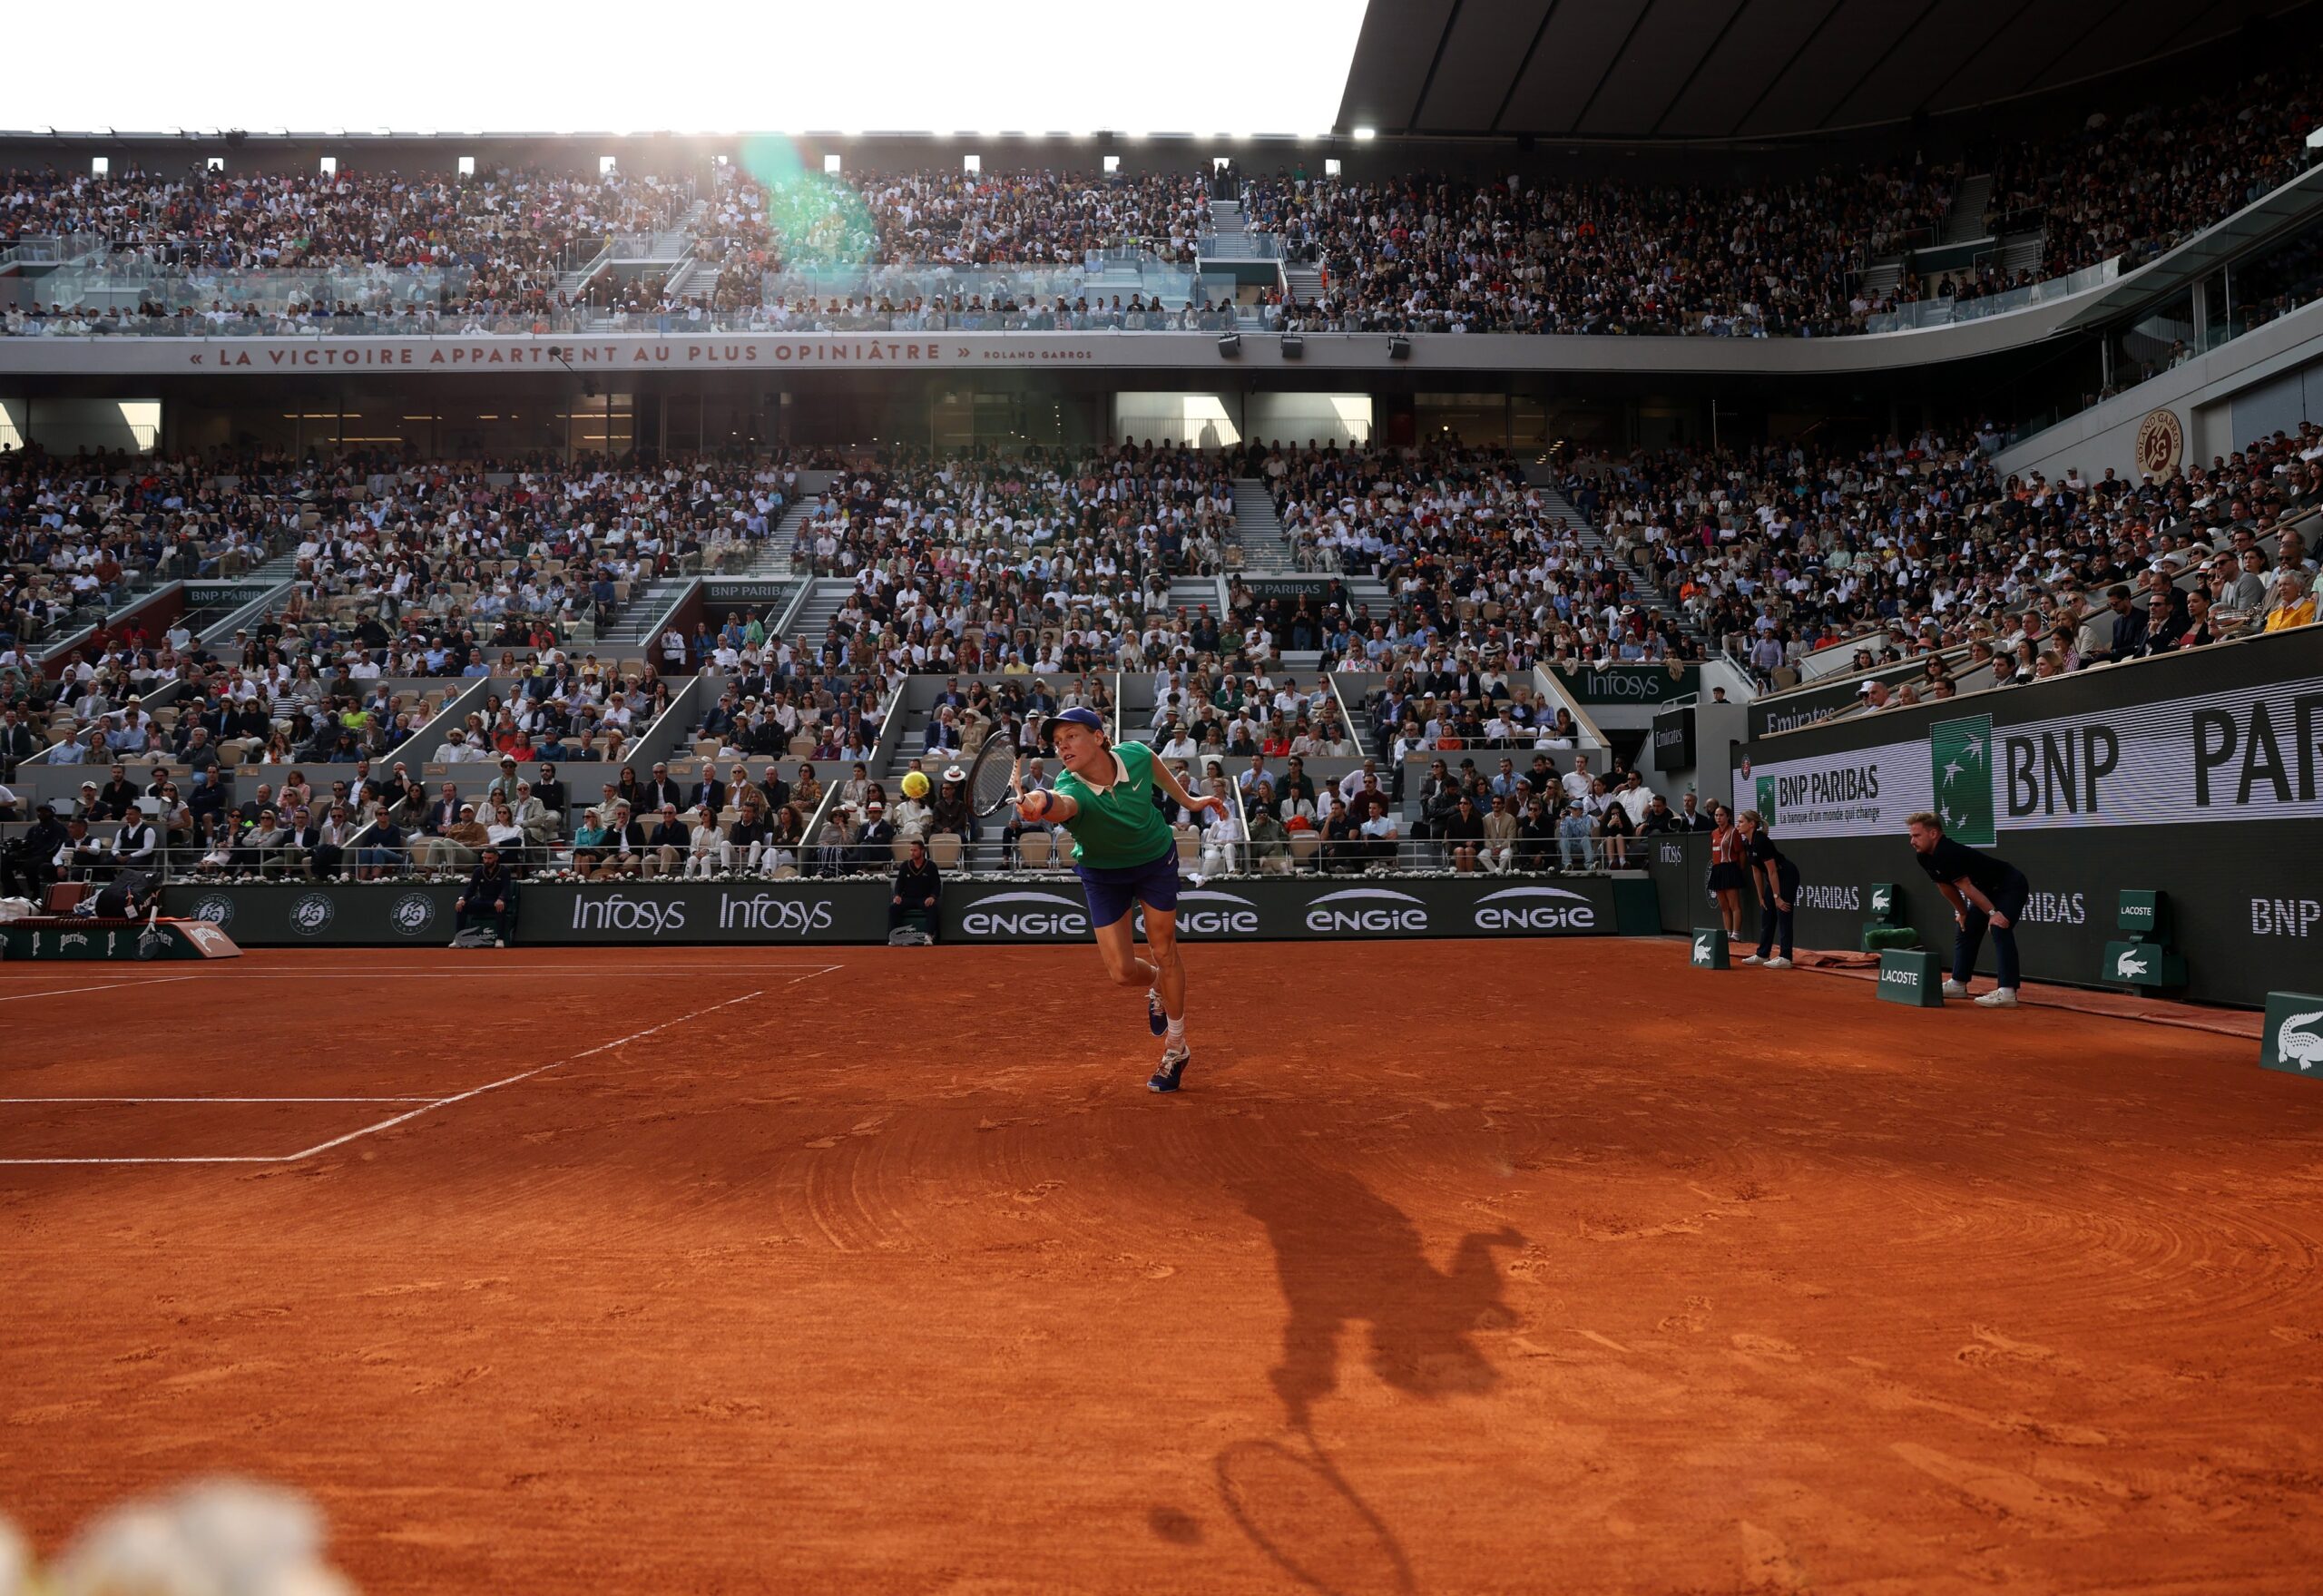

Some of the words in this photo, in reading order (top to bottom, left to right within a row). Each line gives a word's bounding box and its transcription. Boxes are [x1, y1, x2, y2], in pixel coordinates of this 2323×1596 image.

[220, 349, 252, 366] LA
[268, 348, 412, 365] VICTOIRE
[633, 347, 670, 362] AU
[689, 345, 757, 361] PLUS
[775, 340, 939, 361] OPINIÂTRE
[984, 350, 1035, 359] ROLAND
[1041, 350, 1093, 359] GARROS
[2137, 416, 2156, 464] ROLAND
[2158, 413, 2180, 449] GARROS
[191, 591, 219, 601] BNP
[221, 591, 260, 601] PARIB
[711, 586, 739, 596] BNP
[741, 586, 788, 596] PARIBA
[1265, 583, 1320, 594] PARIBAS
[1587, 671, 1660, 700] Infosys
[1656, 728, 1683, 748] Emirates
[2005, 725, 2120, 818] BNP
[1779, 774, 1808, 808] BNP
[1811, 764, 1879, 805] PARIBAS
[1806, 885, 1860, 911] PARIBAS
[2019, 892, 2086, 925] RIBAS
[2121, 906, 2152, 916] LACOSTE
[573, 894, 685, 935] Infosys
[719, 893, 832, 935] Infosys
[2250, 898, 2321, 937] BNP
[1881, 968, 1918, 986] LACOSTE
